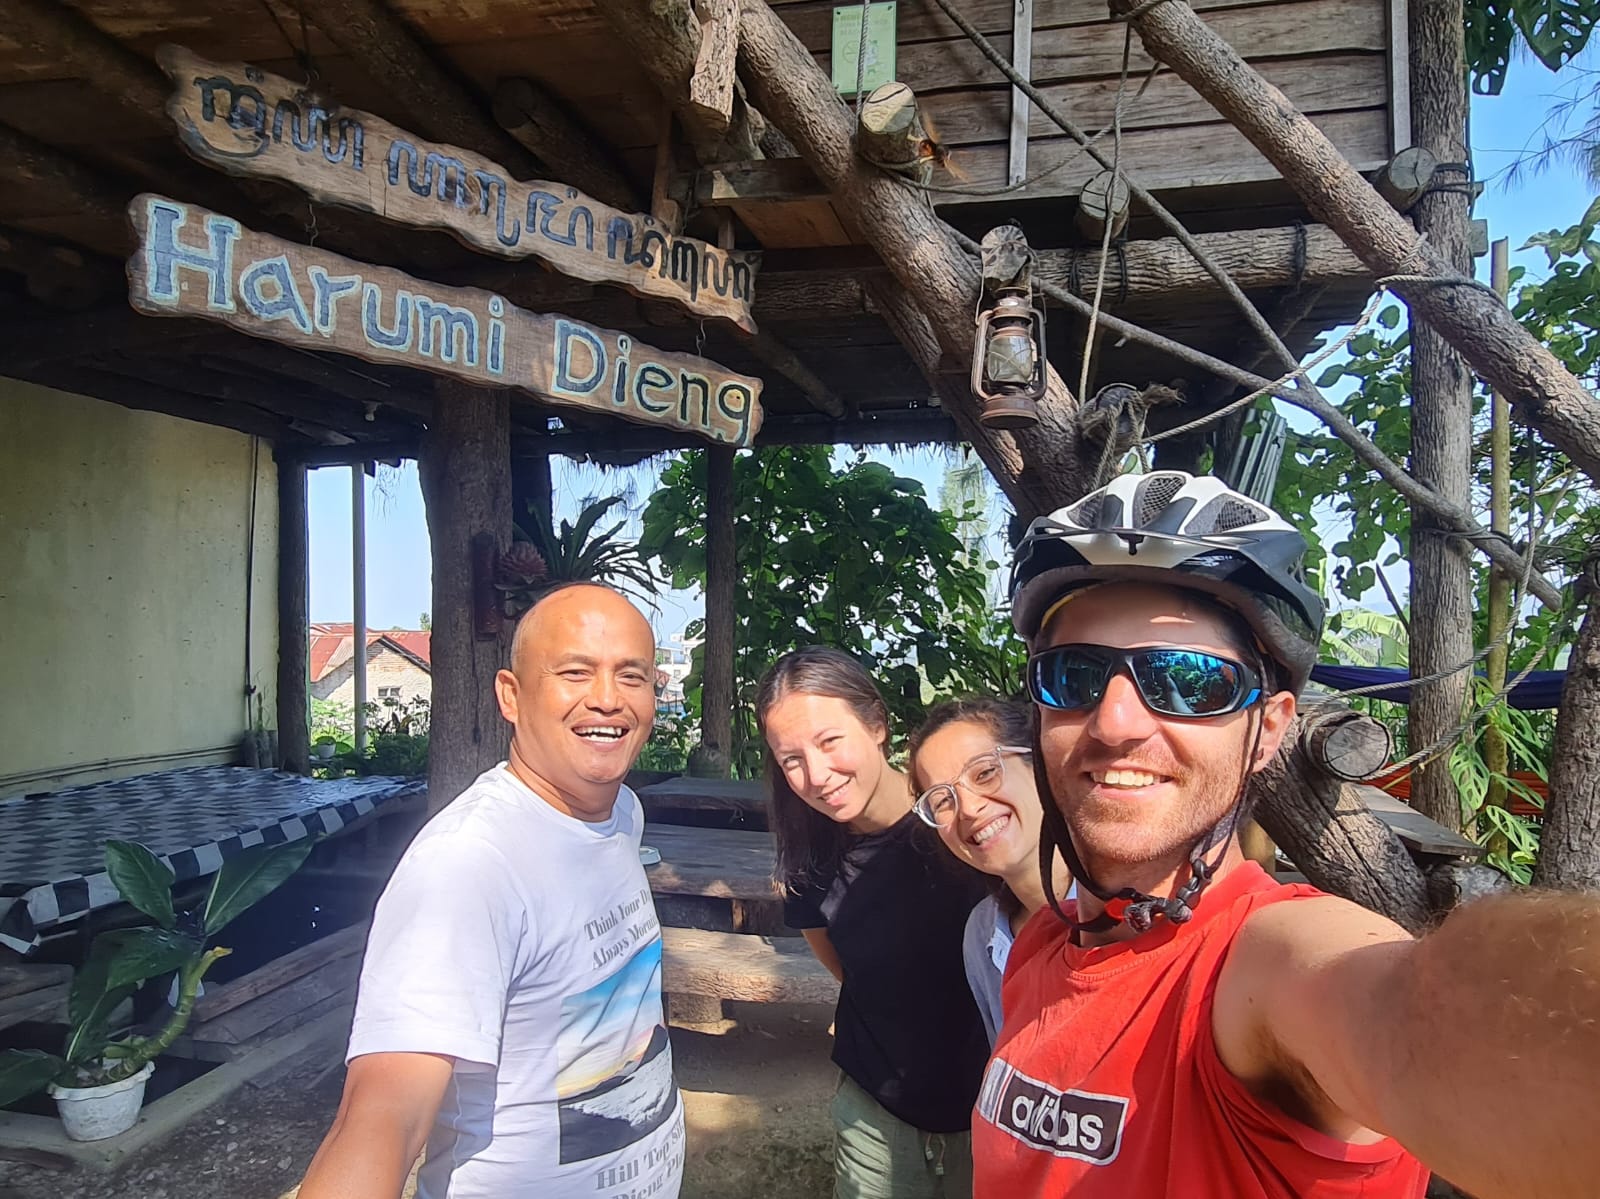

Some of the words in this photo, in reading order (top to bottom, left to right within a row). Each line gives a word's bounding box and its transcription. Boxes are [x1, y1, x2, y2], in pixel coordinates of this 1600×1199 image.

[146, 198, 507, 376] Harumi
[551, 318, 757, 447] Dieng
[584, 910, 618, 941] Think
[618, 898, 641, 921] Your
[592, 937, 629, 971] Always
[1011, 1095, 1104, 1151] adidas
[596, 1158, 639, 1190] Hill
[643, 1142, 670, 1170] Top
